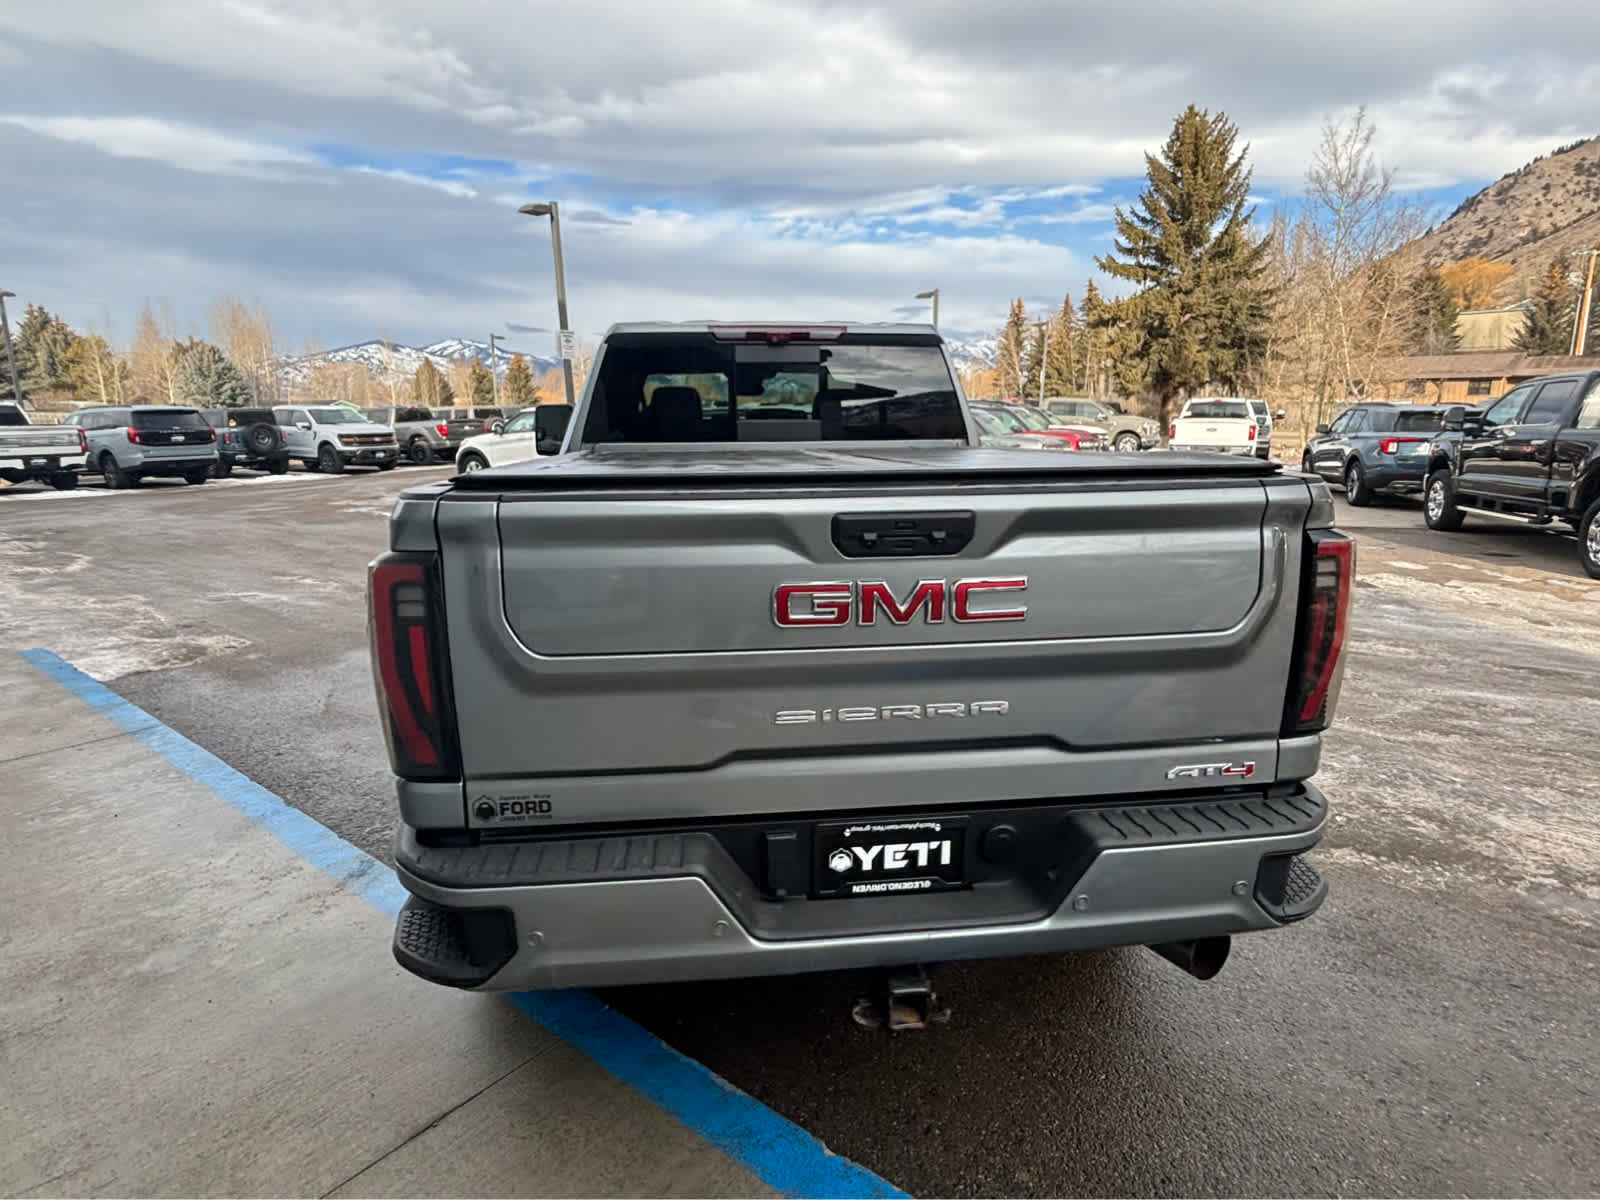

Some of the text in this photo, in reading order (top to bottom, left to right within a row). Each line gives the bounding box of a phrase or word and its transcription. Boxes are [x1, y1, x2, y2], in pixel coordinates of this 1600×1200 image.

[773, 576, 1028, 628] GMC
[775, 700, 1009, 725] SIERRA
[1167, 761, 1256, 779] AT4
[500, 800, 552, 816] FORD
[851, 840, 951, 871] YETI
